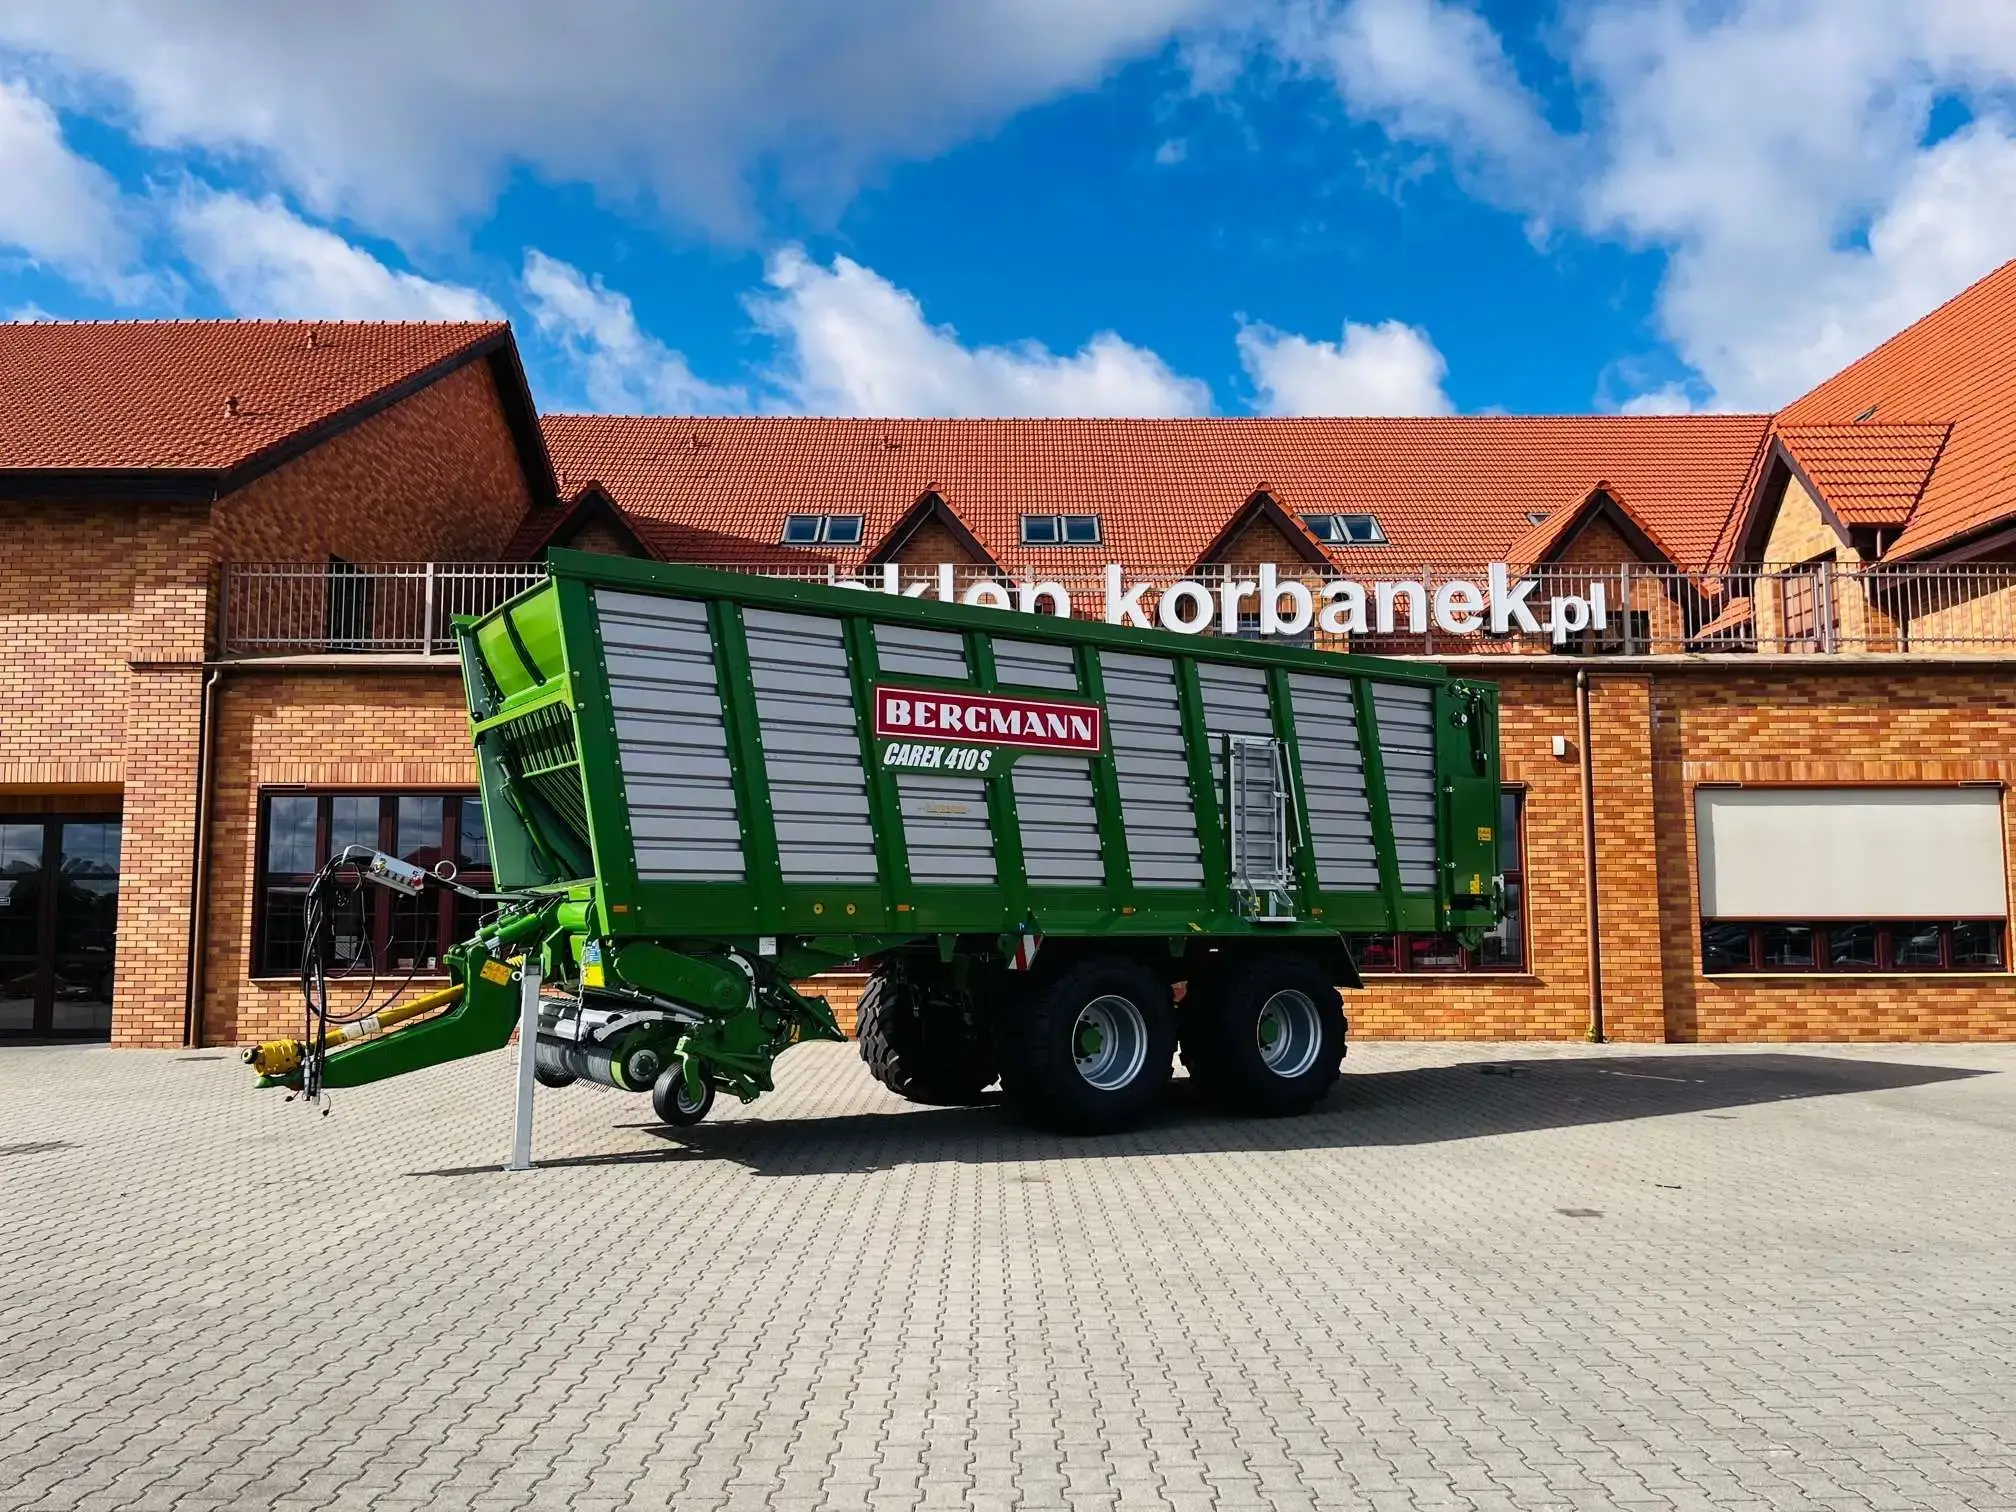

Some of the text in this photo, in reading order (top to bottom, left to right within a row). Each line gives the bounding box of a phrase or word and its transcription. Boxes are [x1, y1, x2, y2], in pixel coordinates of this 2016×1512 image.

[1106, 562, 1606, 644] korbanek.pl
[886, 698, 1091, 741] BERGMANN
[883, 743, 945, 768] CAREX
